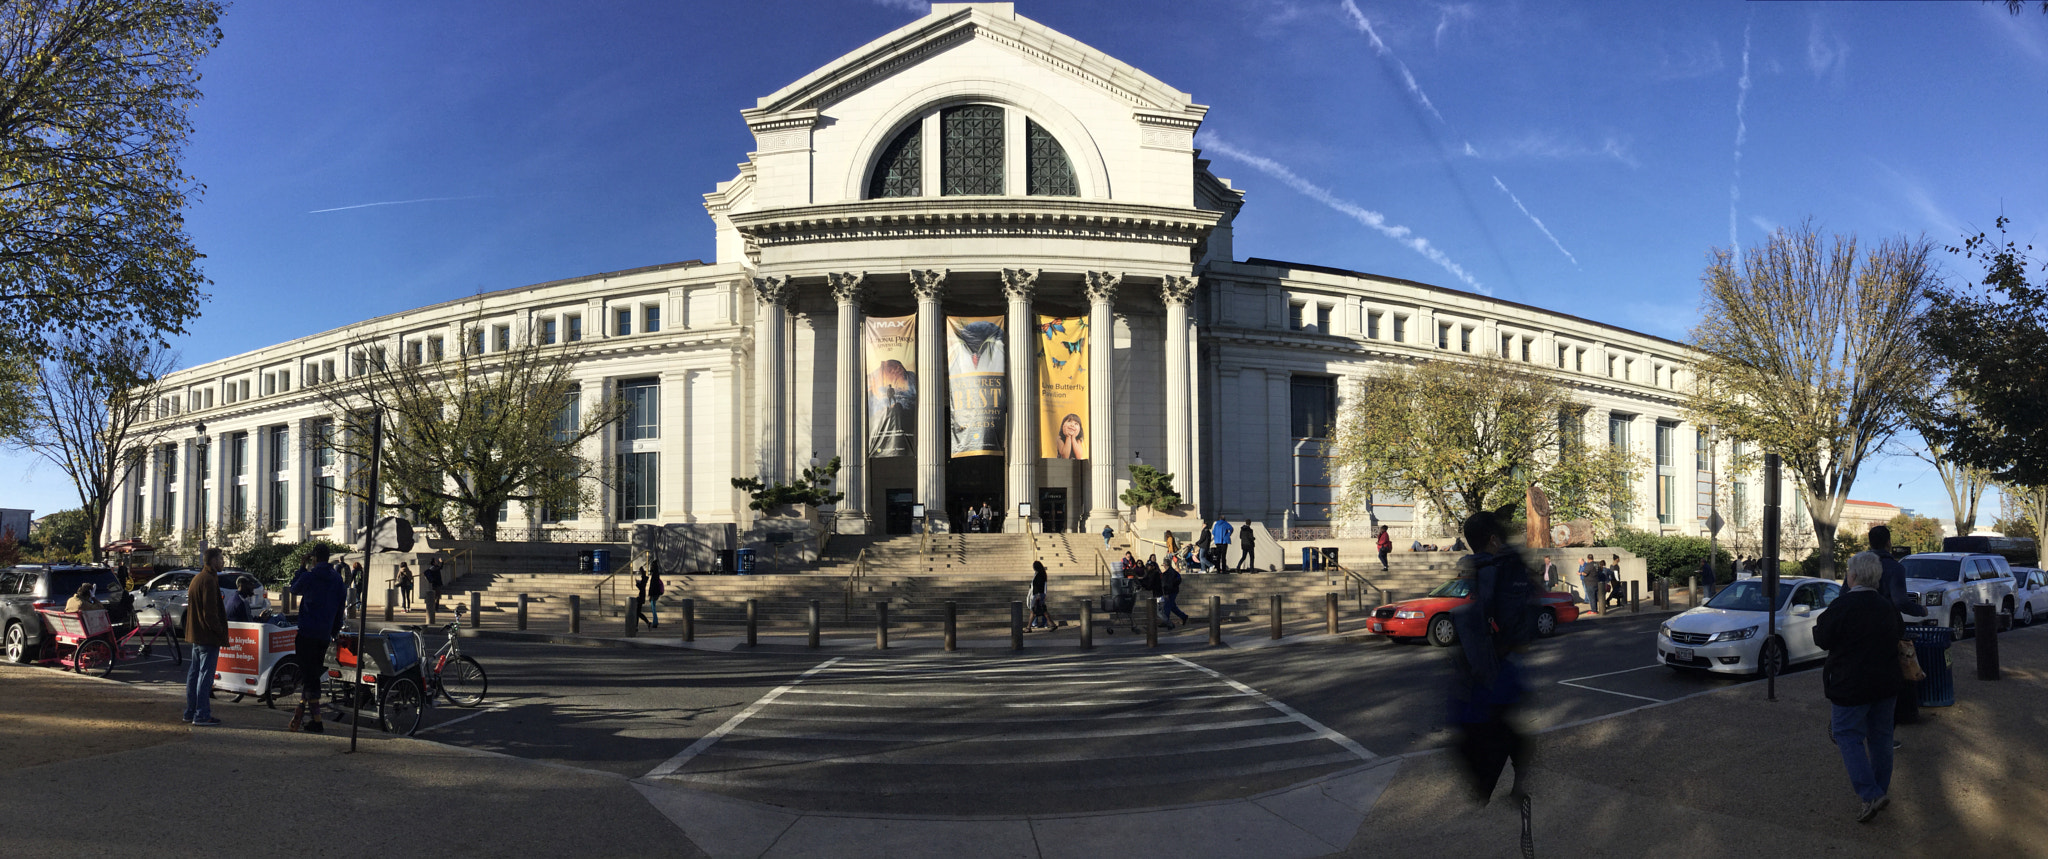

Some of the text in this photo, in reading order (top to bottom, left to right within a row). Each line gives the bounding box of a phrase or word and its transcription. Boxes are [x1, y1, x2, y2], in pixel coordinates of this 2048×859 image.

[873, 321, 905, 329] IMAX
[953, 378, 1001, 388] NATURE'S
[1055, 383, 1085, 391] Butterfly
[1042, 389, 1067, 398] Pavilion
[953, 387, 1001, 411] BEST
